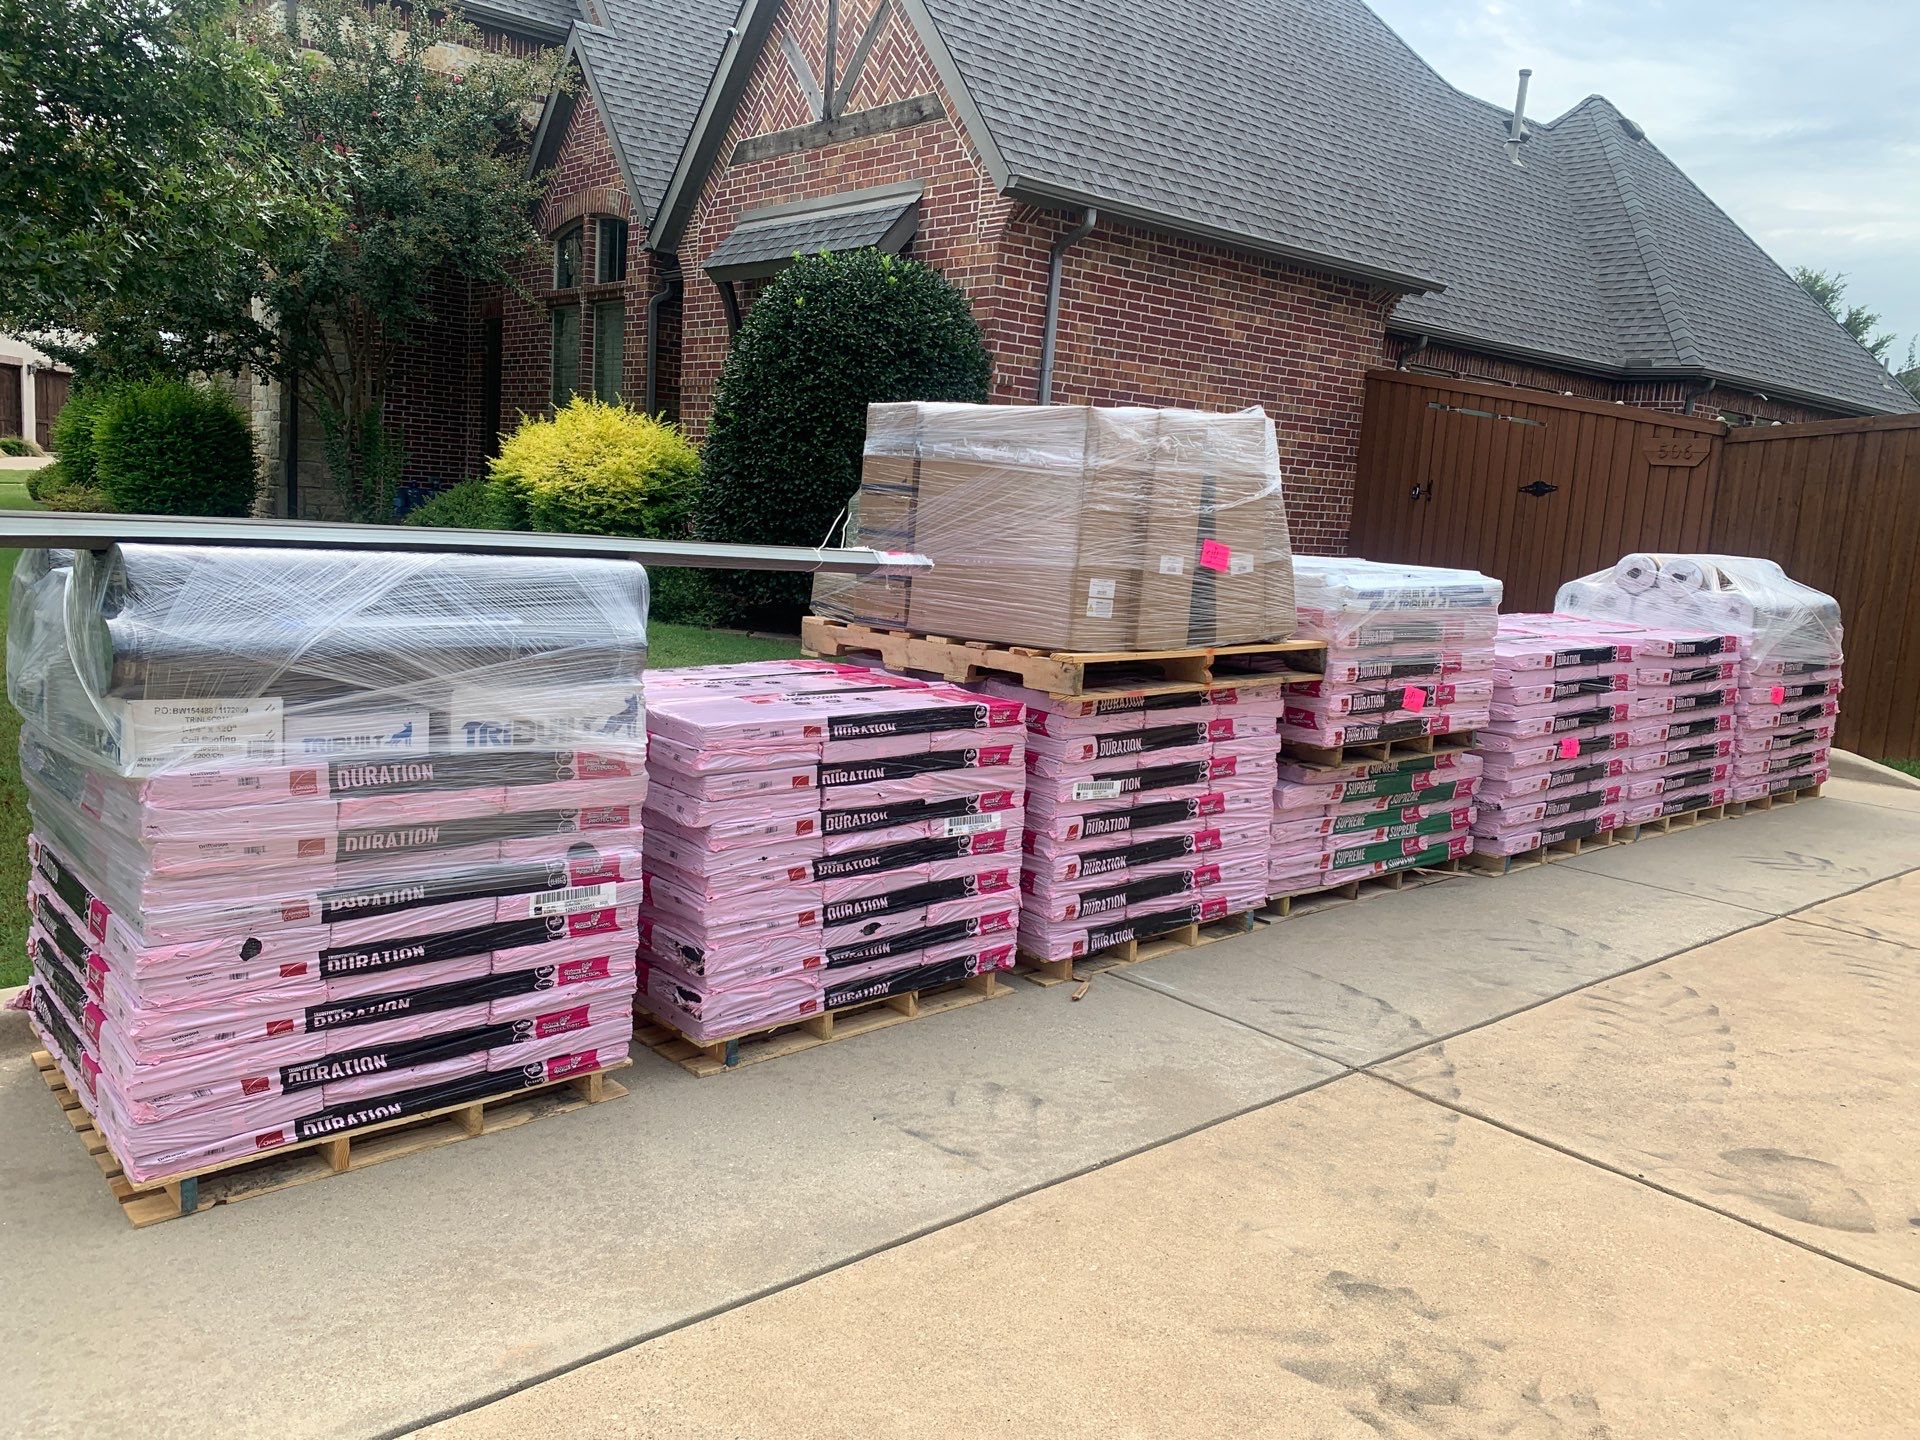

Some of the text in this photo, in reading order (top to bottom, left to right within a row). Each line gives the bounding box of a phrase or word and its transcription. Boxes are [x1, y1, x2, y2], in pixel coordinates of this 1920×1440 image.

[1353, 694, 1385, 711] DURATION
[1345, 726, 1379, 743] DURATION
[1099, 738, 1142, 757] DURATION
[337, 763, 435, 790] DURATION
[1346, 779, 1377, 795] SUPREME
[826, 811, 888, 831] DURATION
[1085, 816, 1130, 836] DURATION
[1335, 814, 1367, 829] SUPREME
[1389, 822, 1418, 837] SUPREME
[345, 826, 440, 852] DURATION
[1335, 847, 1366, 864] SUPREME
[818, 856, 880, 876] DURATION
[1082, 856, 1127, 876] DURATION
[330, 884, 425, 912] DURATION
[1081, 893, 1126, 917] DURATION
[827, 896, 889, 921] DURATION
[1090, 928, 1134, 952] DURATION
[303, 1102, 402, 1136] DURATION
